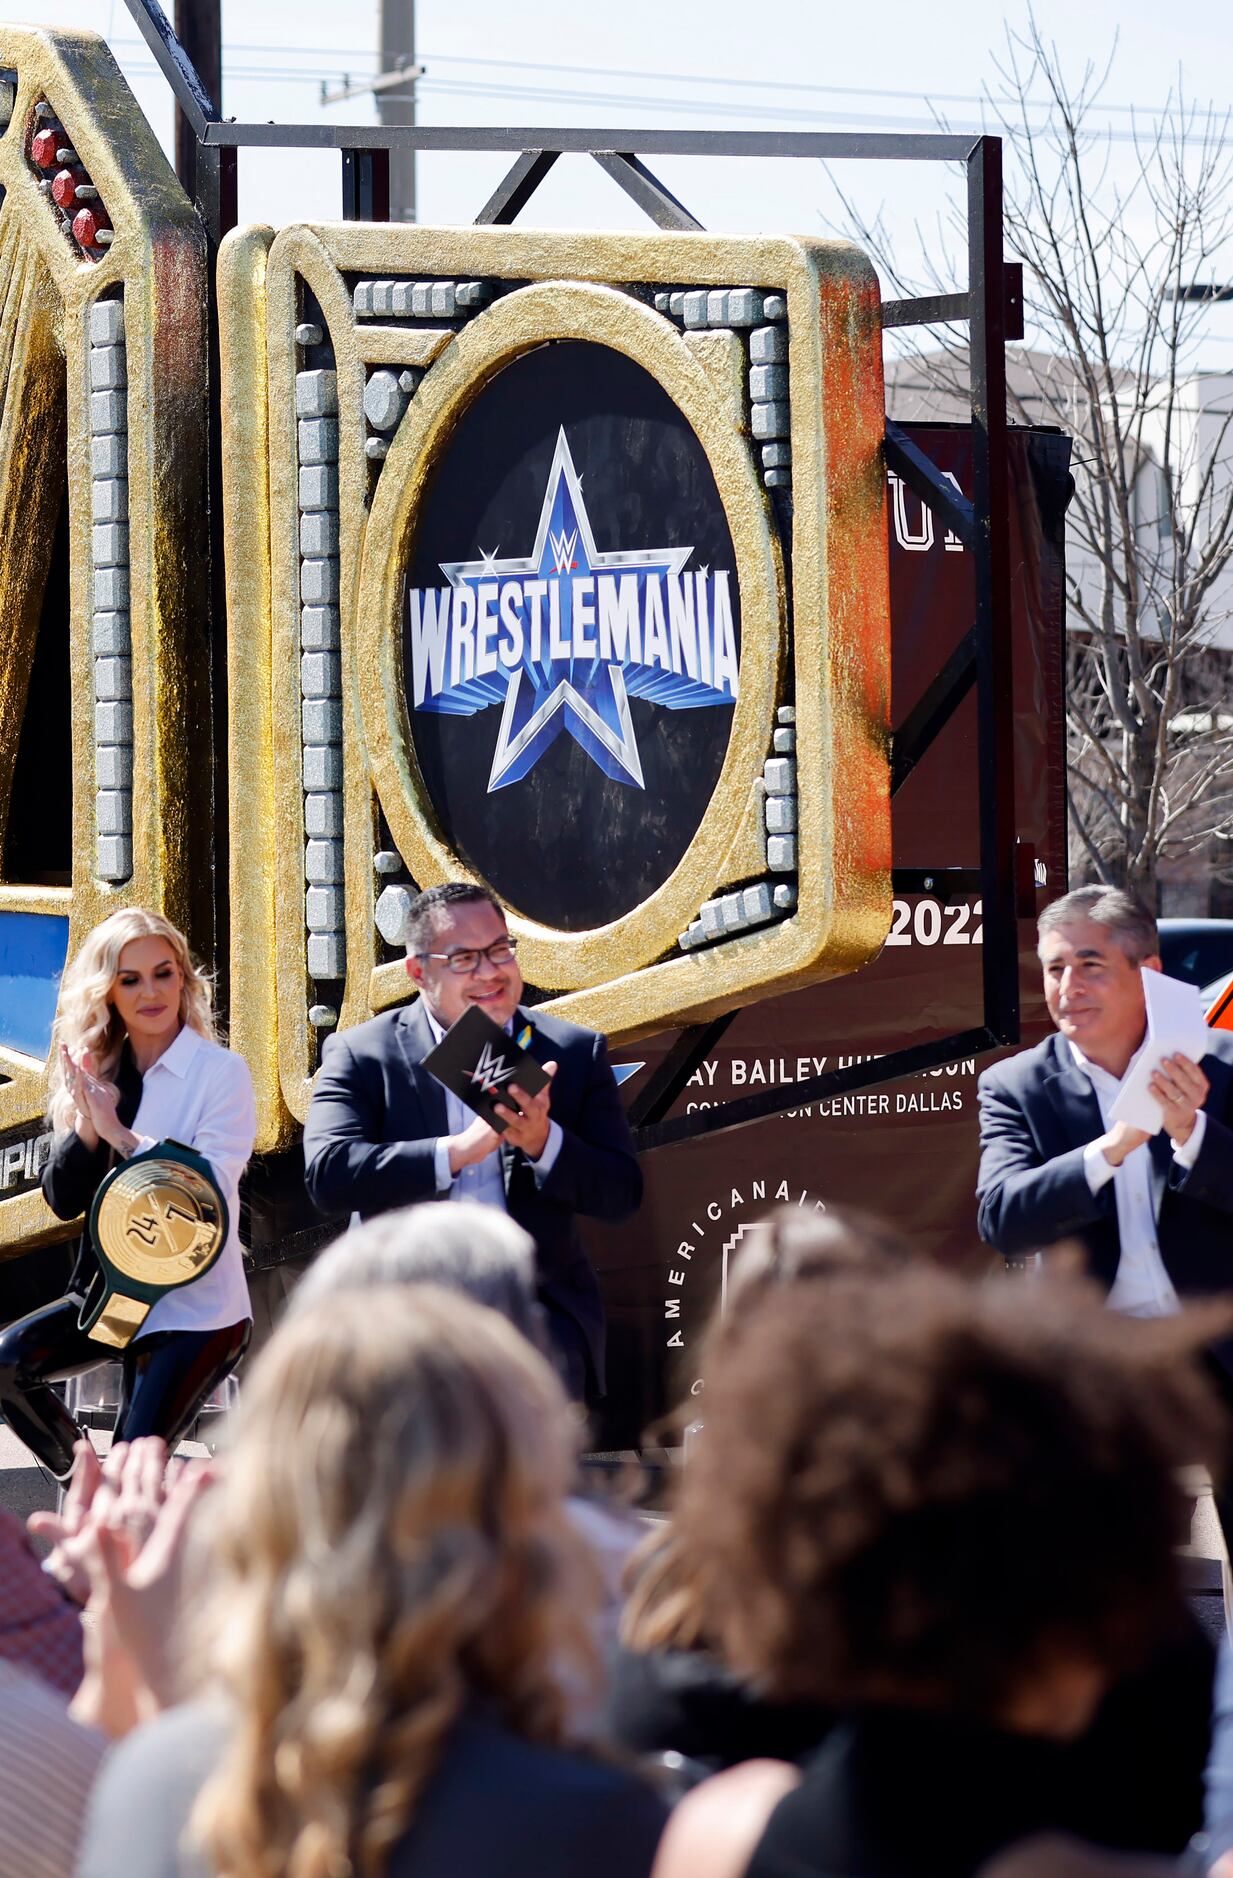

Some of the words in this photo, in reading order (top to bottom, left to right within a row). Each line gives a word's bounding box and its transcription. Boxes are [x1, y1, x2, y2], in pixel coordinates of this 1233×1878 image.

[409, 569, 740, 709] WRESTLEMANIA
[686, 1059, 719, 1086] AY
[731, 1056, 828, 1086] BAILEY
[819, 1094, 890, 1117] CENTER
[896, 1090, 963, 1113] DALLAS
